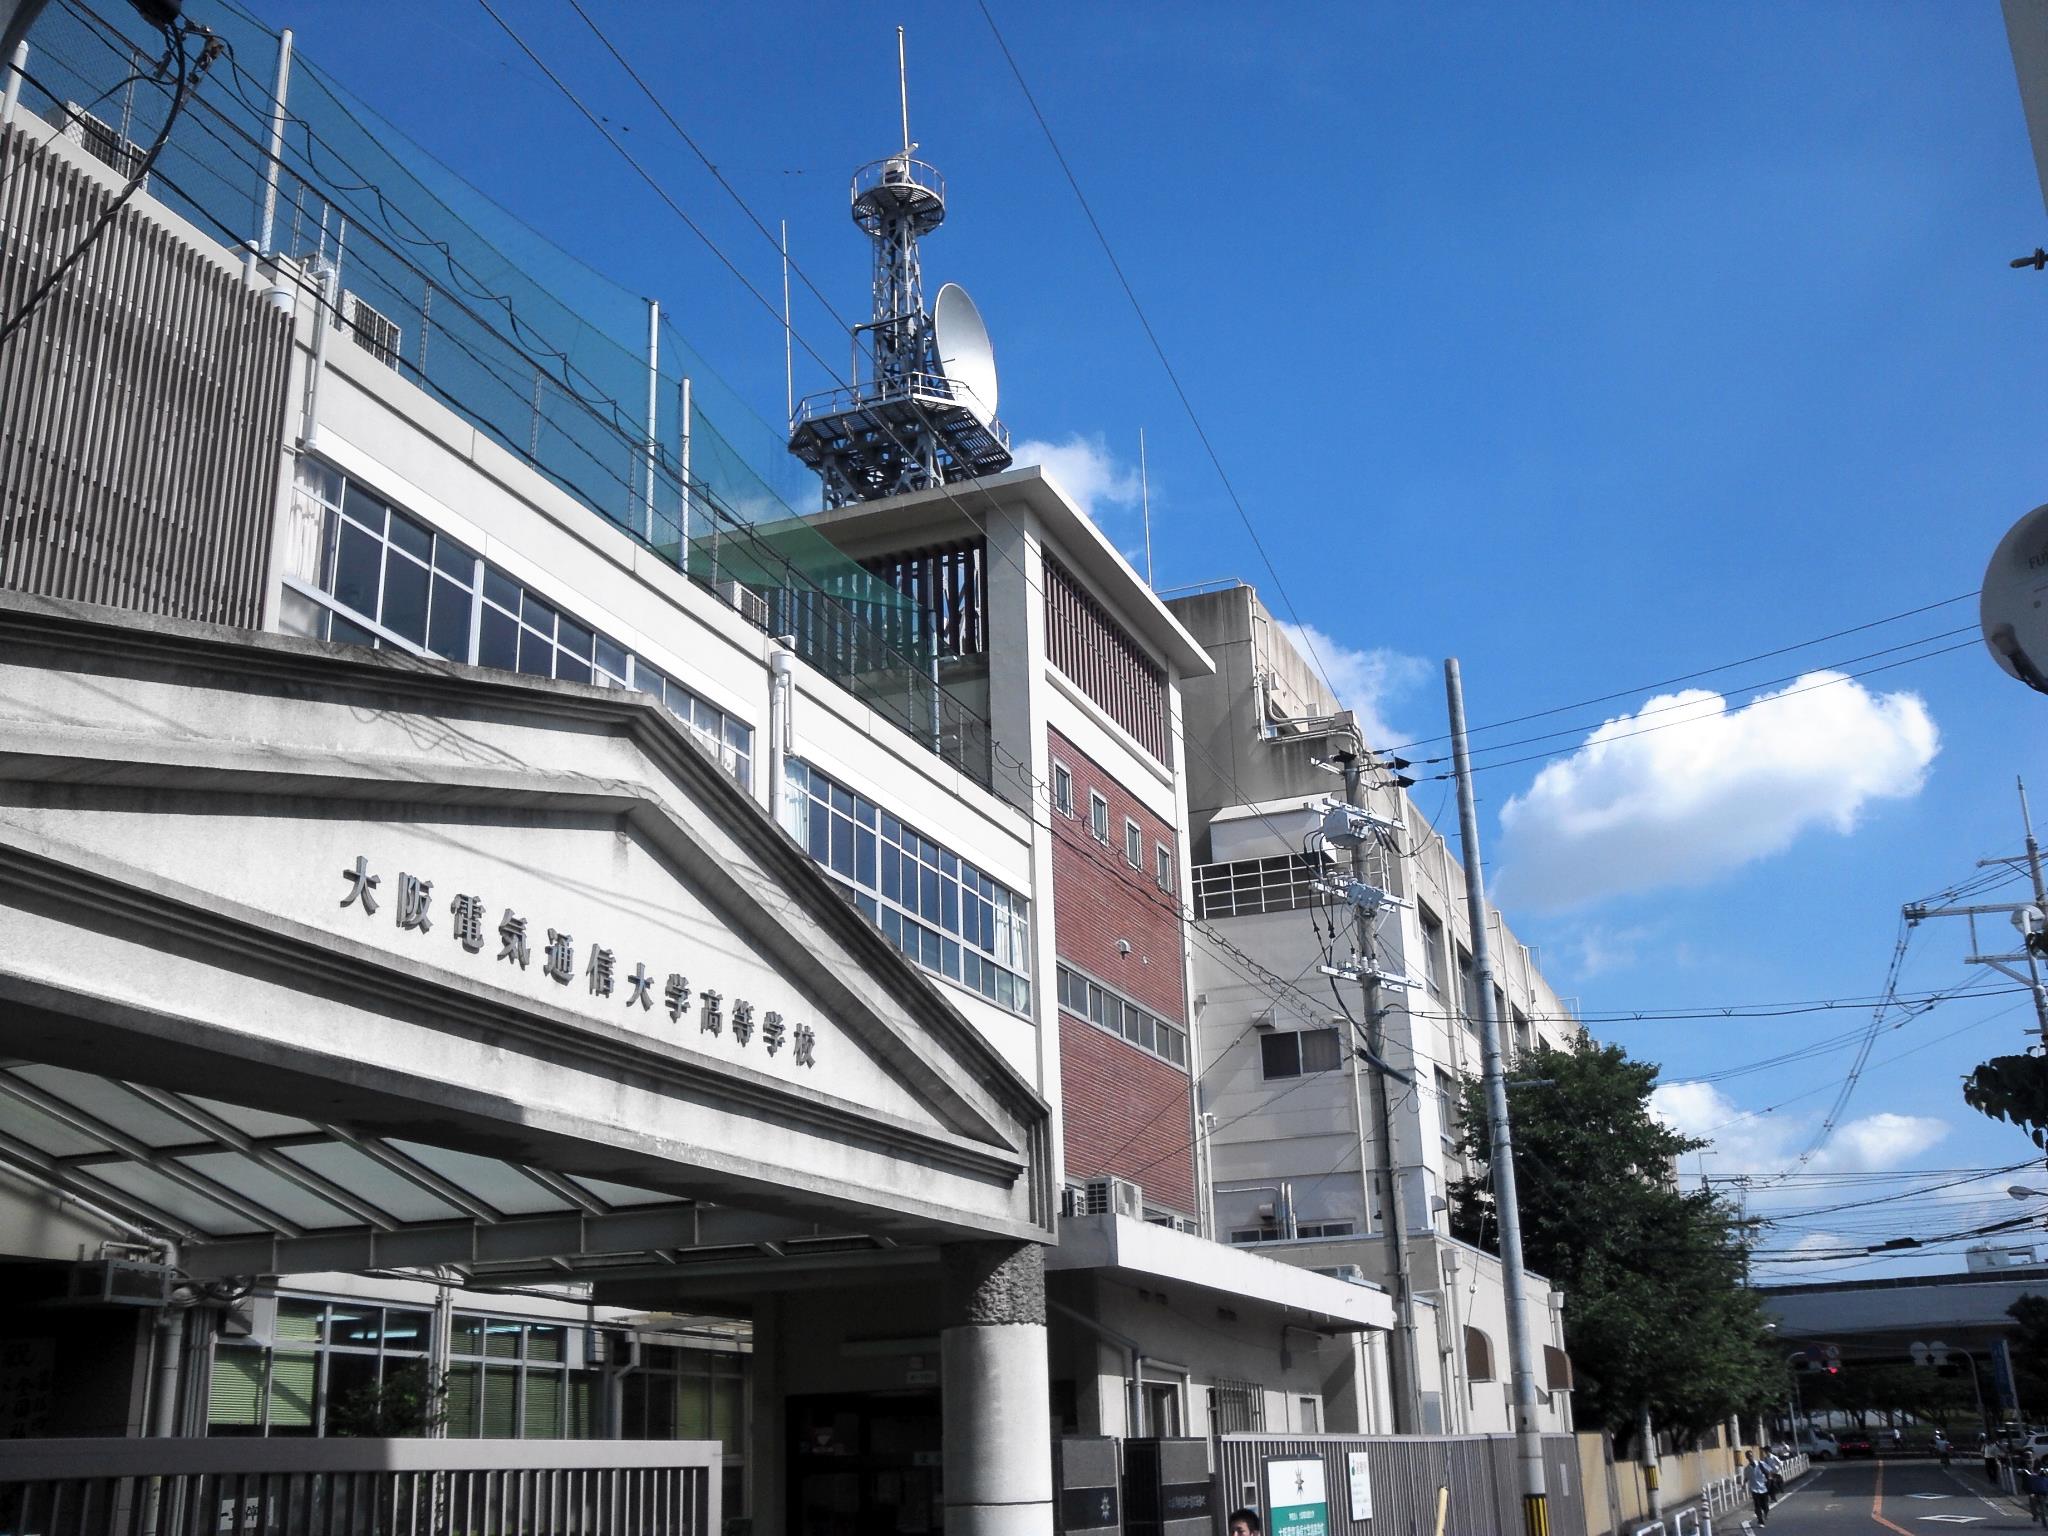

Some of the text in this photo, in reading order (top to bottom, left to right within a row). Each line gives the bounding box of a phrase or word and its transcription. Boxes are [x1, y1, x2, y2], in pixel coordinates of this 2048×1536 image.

[340, 856, 816, 1069] 大阪電気通信大学高等学校
